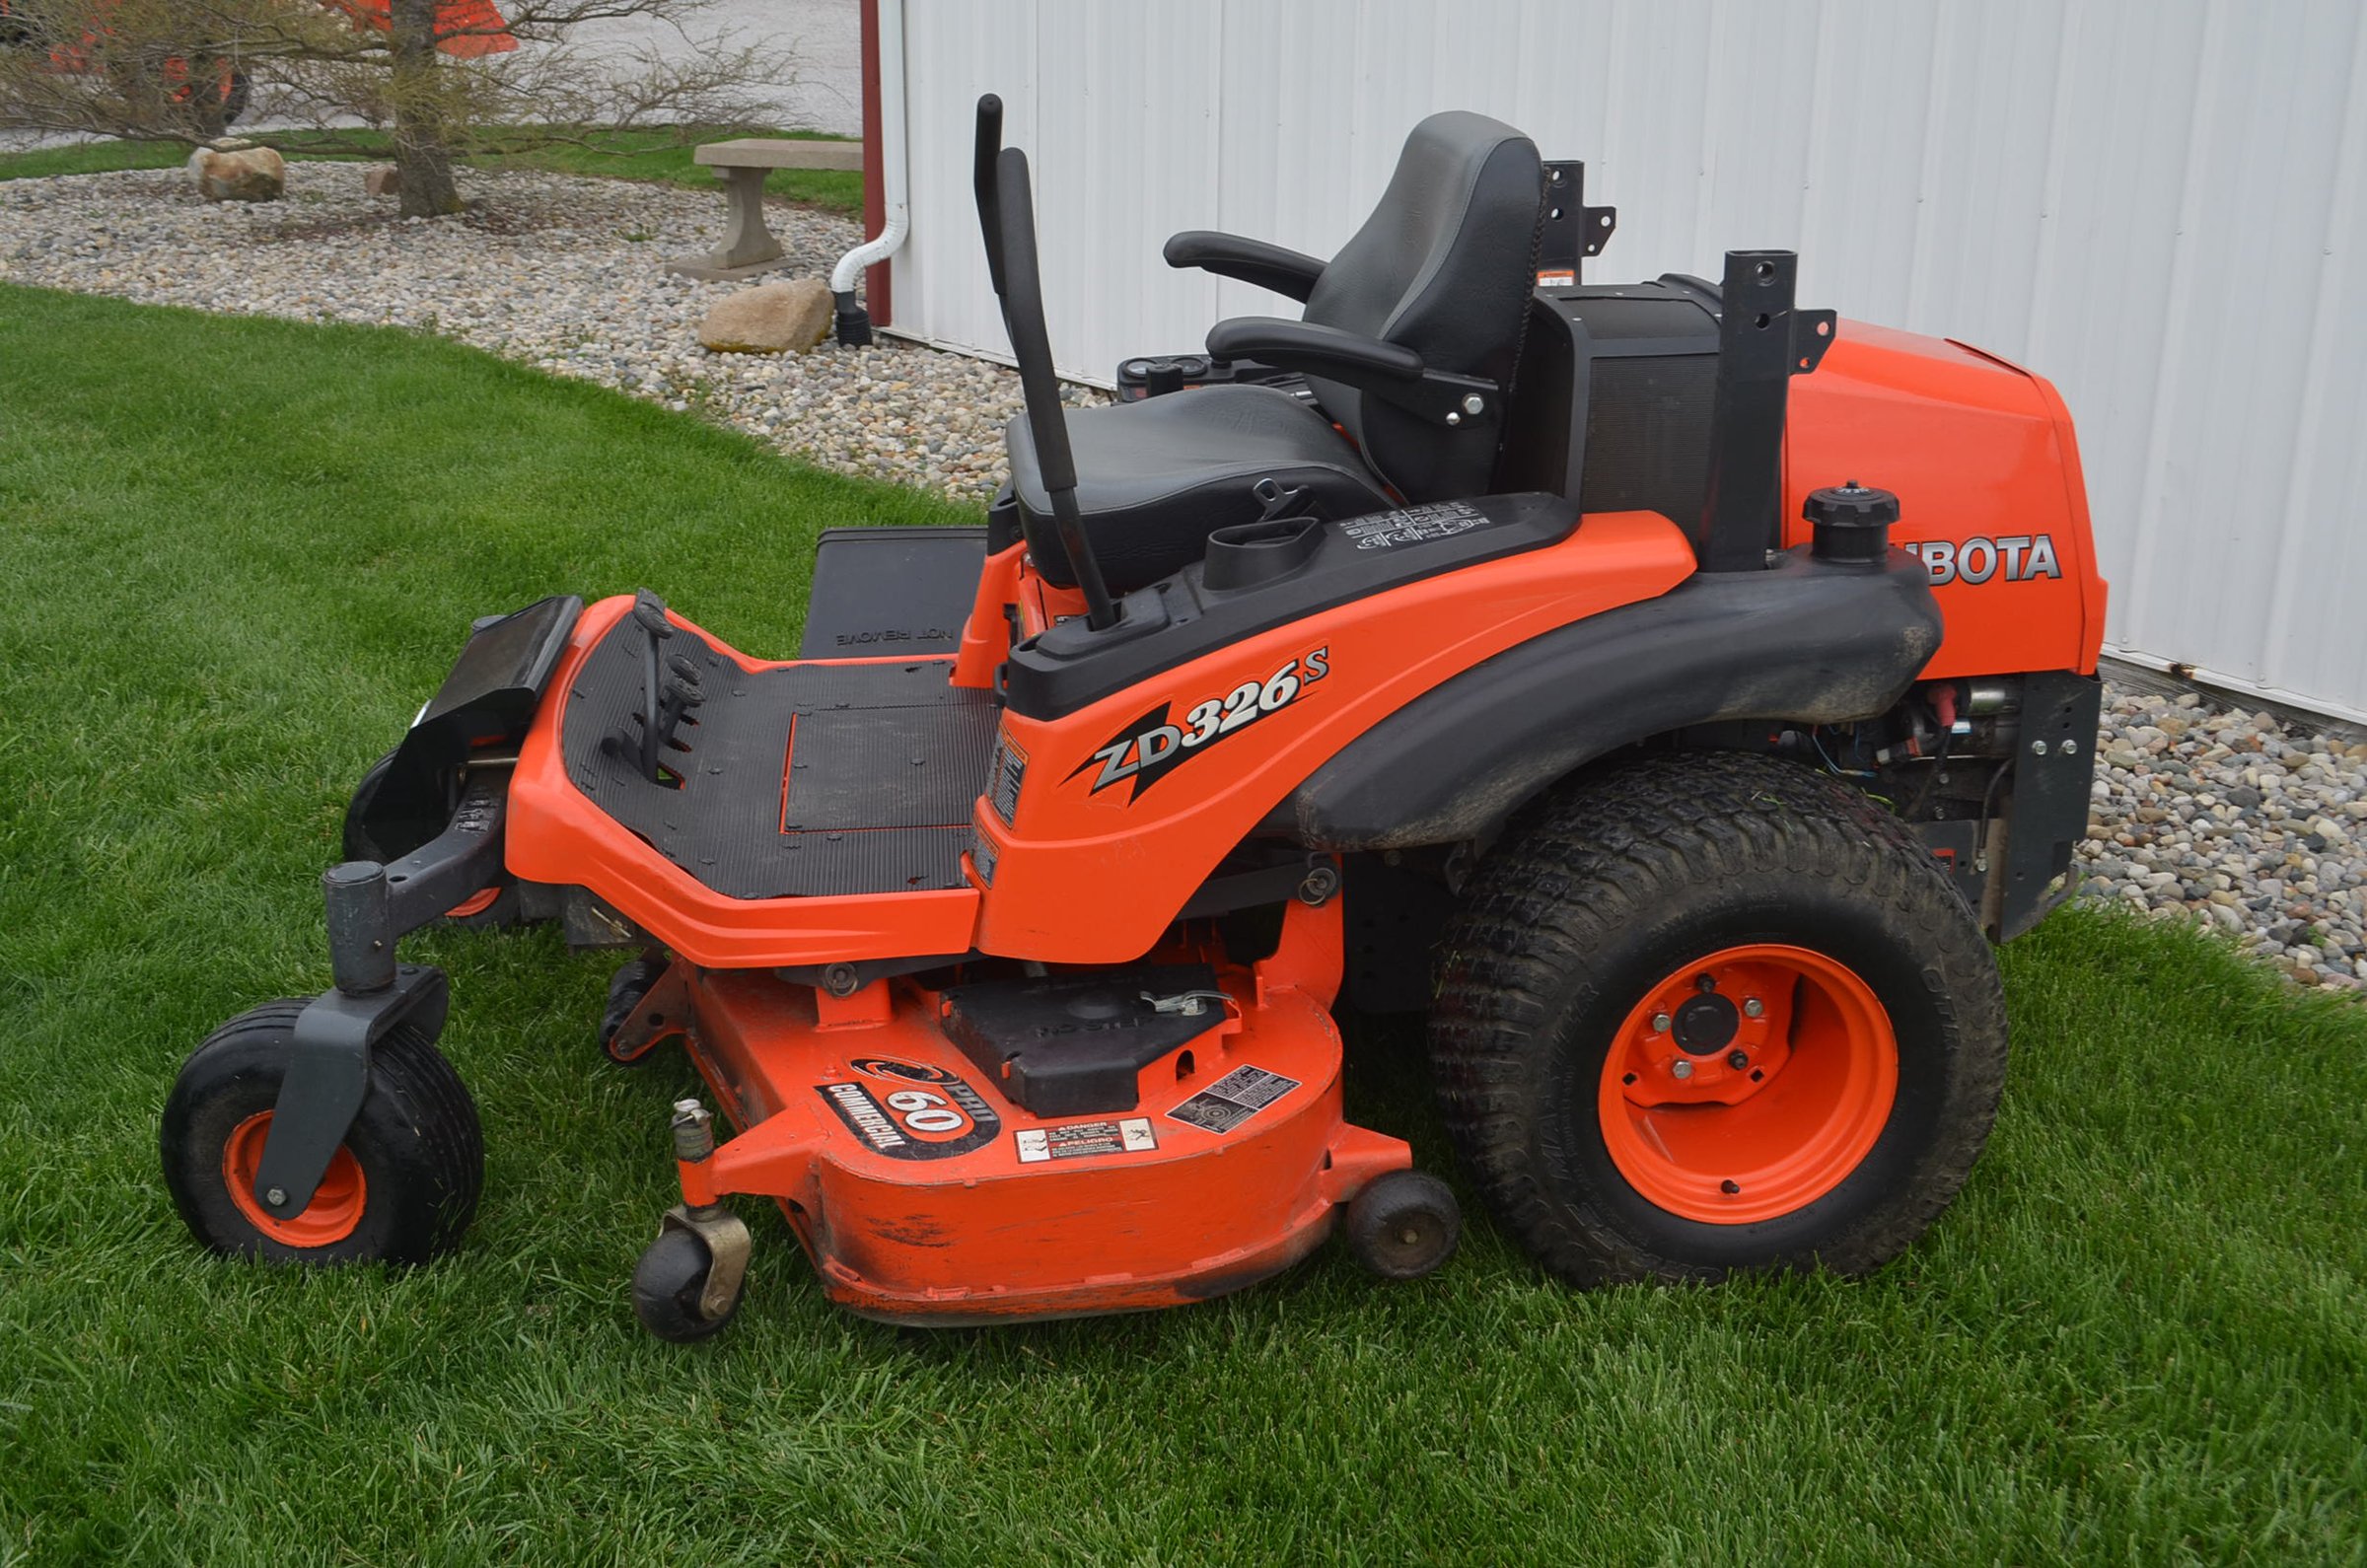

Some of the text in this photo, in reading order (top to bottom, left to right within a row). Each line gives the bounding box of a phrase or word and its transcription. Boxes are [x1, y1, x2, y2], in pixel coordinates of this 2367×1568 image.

[1904, 534, 2063, 587] BOTA
[835, 627, 954, 647] NOT REMOVE
[826, 1083, 907, 1150] COMMERCIAL
[887, 1090, 965, 1133] 60
[944, 1085, 998, 1122] PRO
[1066, 1121, 1108, 1130] DANGER
[1067, 1137, 1113, 1146] PELIGRO
